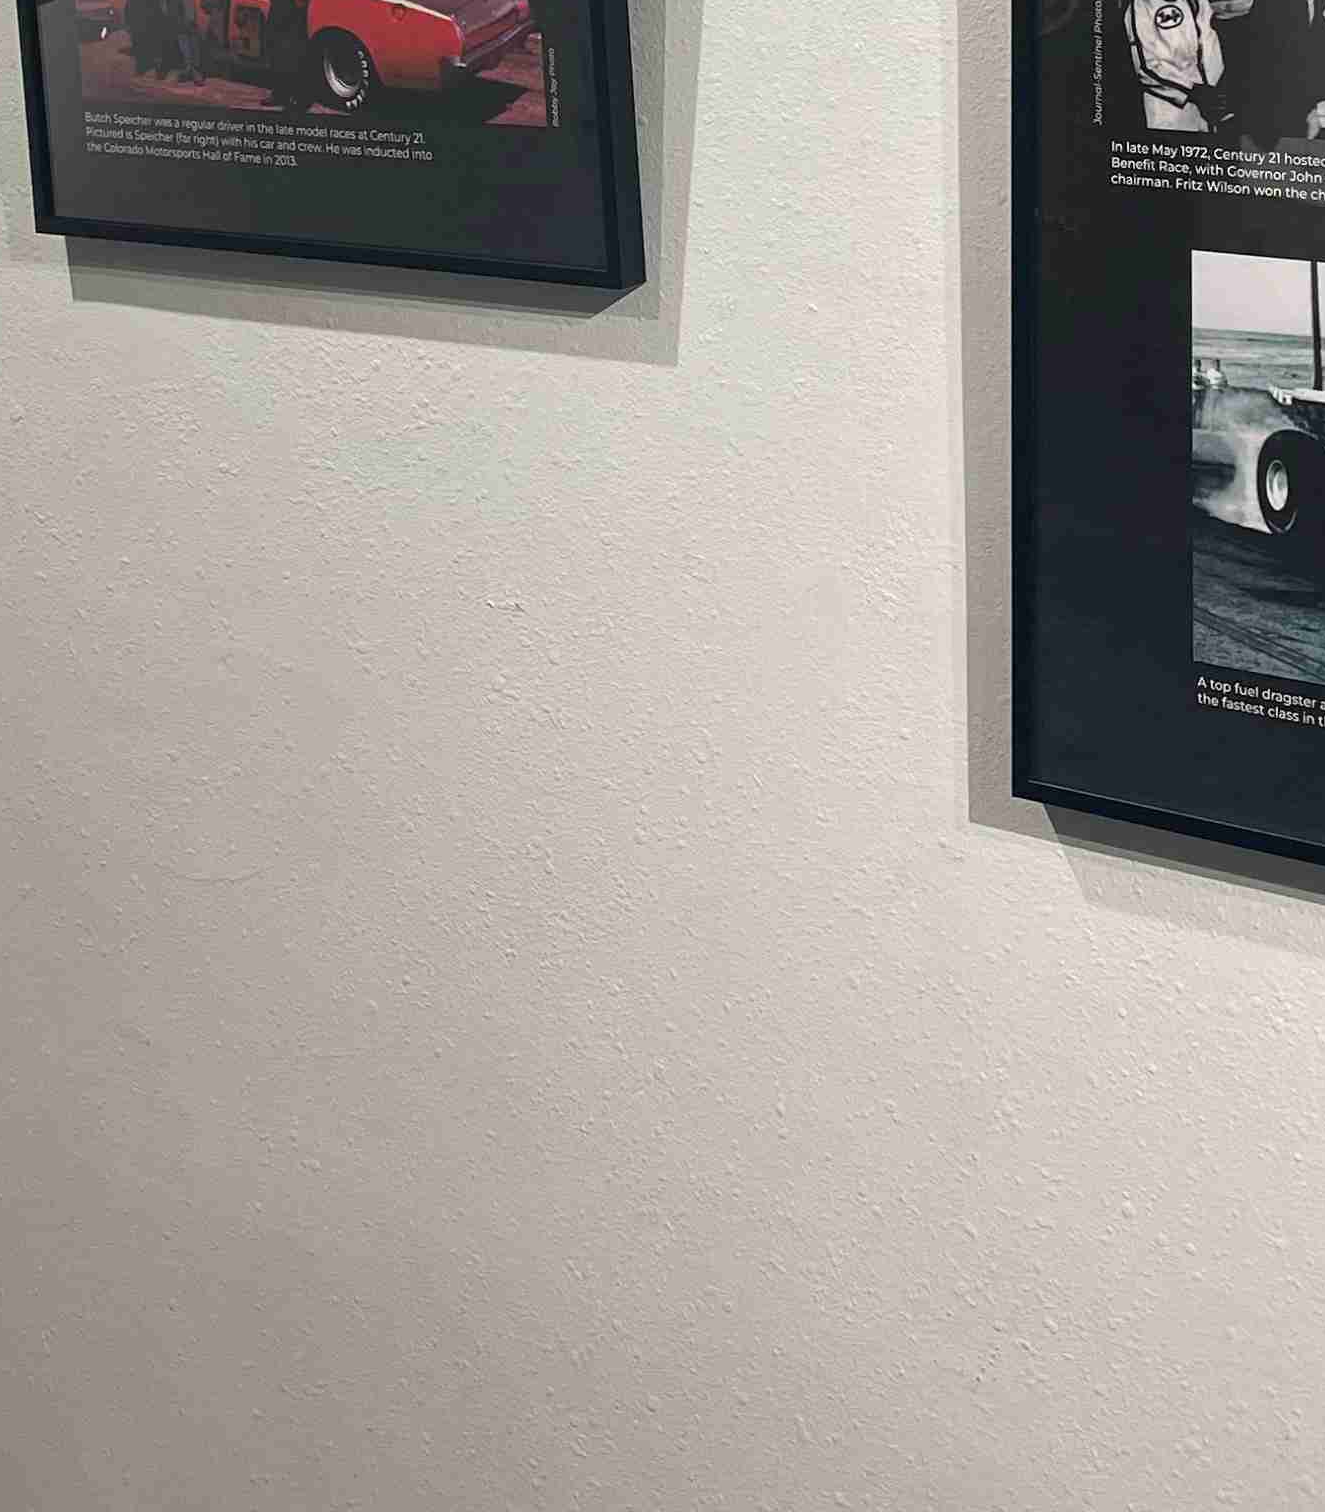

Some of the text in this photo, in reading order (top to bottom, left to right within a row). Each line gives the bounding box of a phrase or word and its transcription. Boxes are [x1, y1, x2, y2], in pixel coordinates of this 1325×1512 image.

[1111, 140, 1123, 152] In
[1126, 141, 1149, 154] late
[1151, 143, 1178, 159] May
[1180, 145, 1211, 161] 1972,
[1213, 148, 1265, 165] Century
[1268, 151, 1280, 164] 21
[1111, 156, 1155, 172] Benefit
[1158, 160, 1192, 176] Race,
[1194, 162, 1224, 176] with
[1226, 164, 1286, 181] Governor
[1289, 169, 1322, 184] John
[1110, 172, 1173, 188] chairman.
[1175, 177, 1203, 191] Fritz
[1206, 179, 1250, 194] Wilson
[1253, 186, 1284, 197] won
[1285, 187, 1308, 199] the
[1197, 676, 1207, 688] A
[1209, 679, 1231, 694] top
[1234, 682, 1259, 698] fuel
[1261, 688, 1316, 708] dragster
[1197, 692, 1219, 706] the
[1221, 696, 1265, 716] fastest
[1267, 706, 1300, 722] class
[1302, 711, 1315, 725] in
